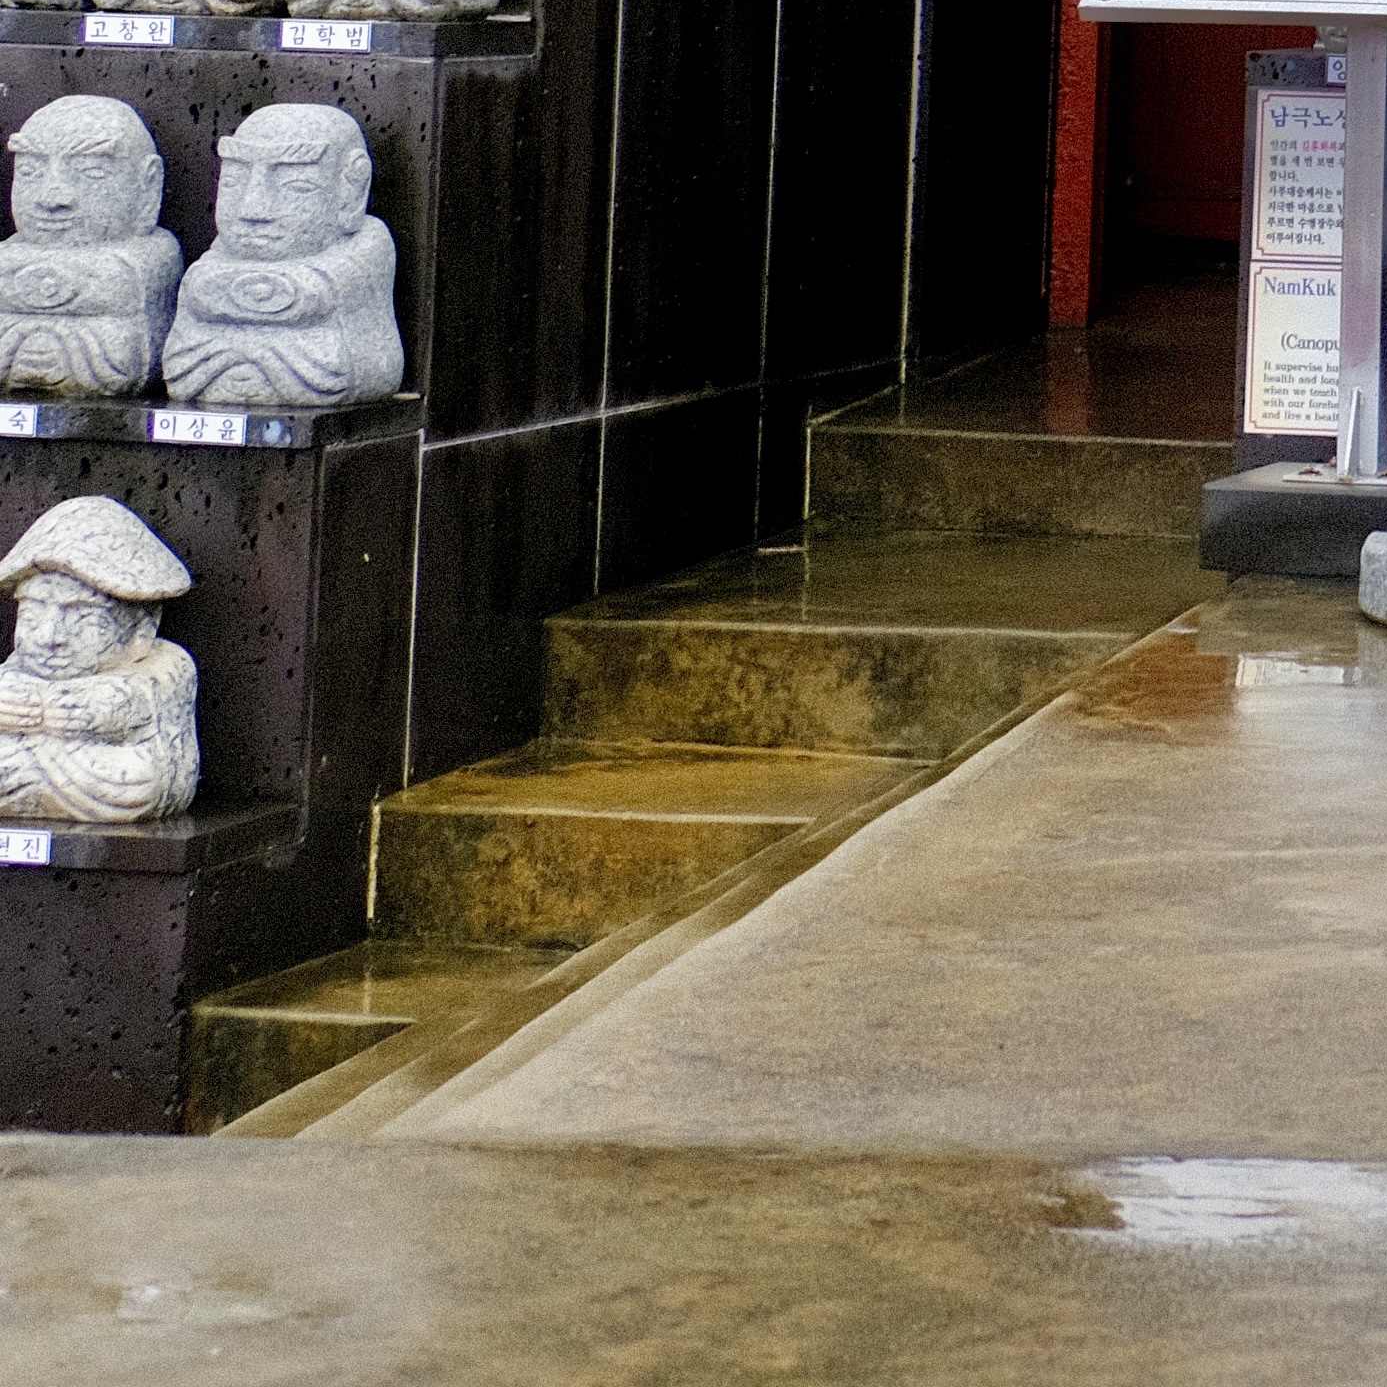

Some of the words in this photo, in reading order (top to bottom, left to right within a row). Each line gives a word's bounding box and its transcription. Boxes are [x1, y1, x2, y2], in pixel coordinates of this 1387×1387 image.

[290, 26, 363, 47] 김학범
[1263, 276, 1336, 296] NamKuk
[1263, 373, 1295, 383] health
[1298, 375, 1317, 384] and
[159, 415, 238, 441] 이상윤
